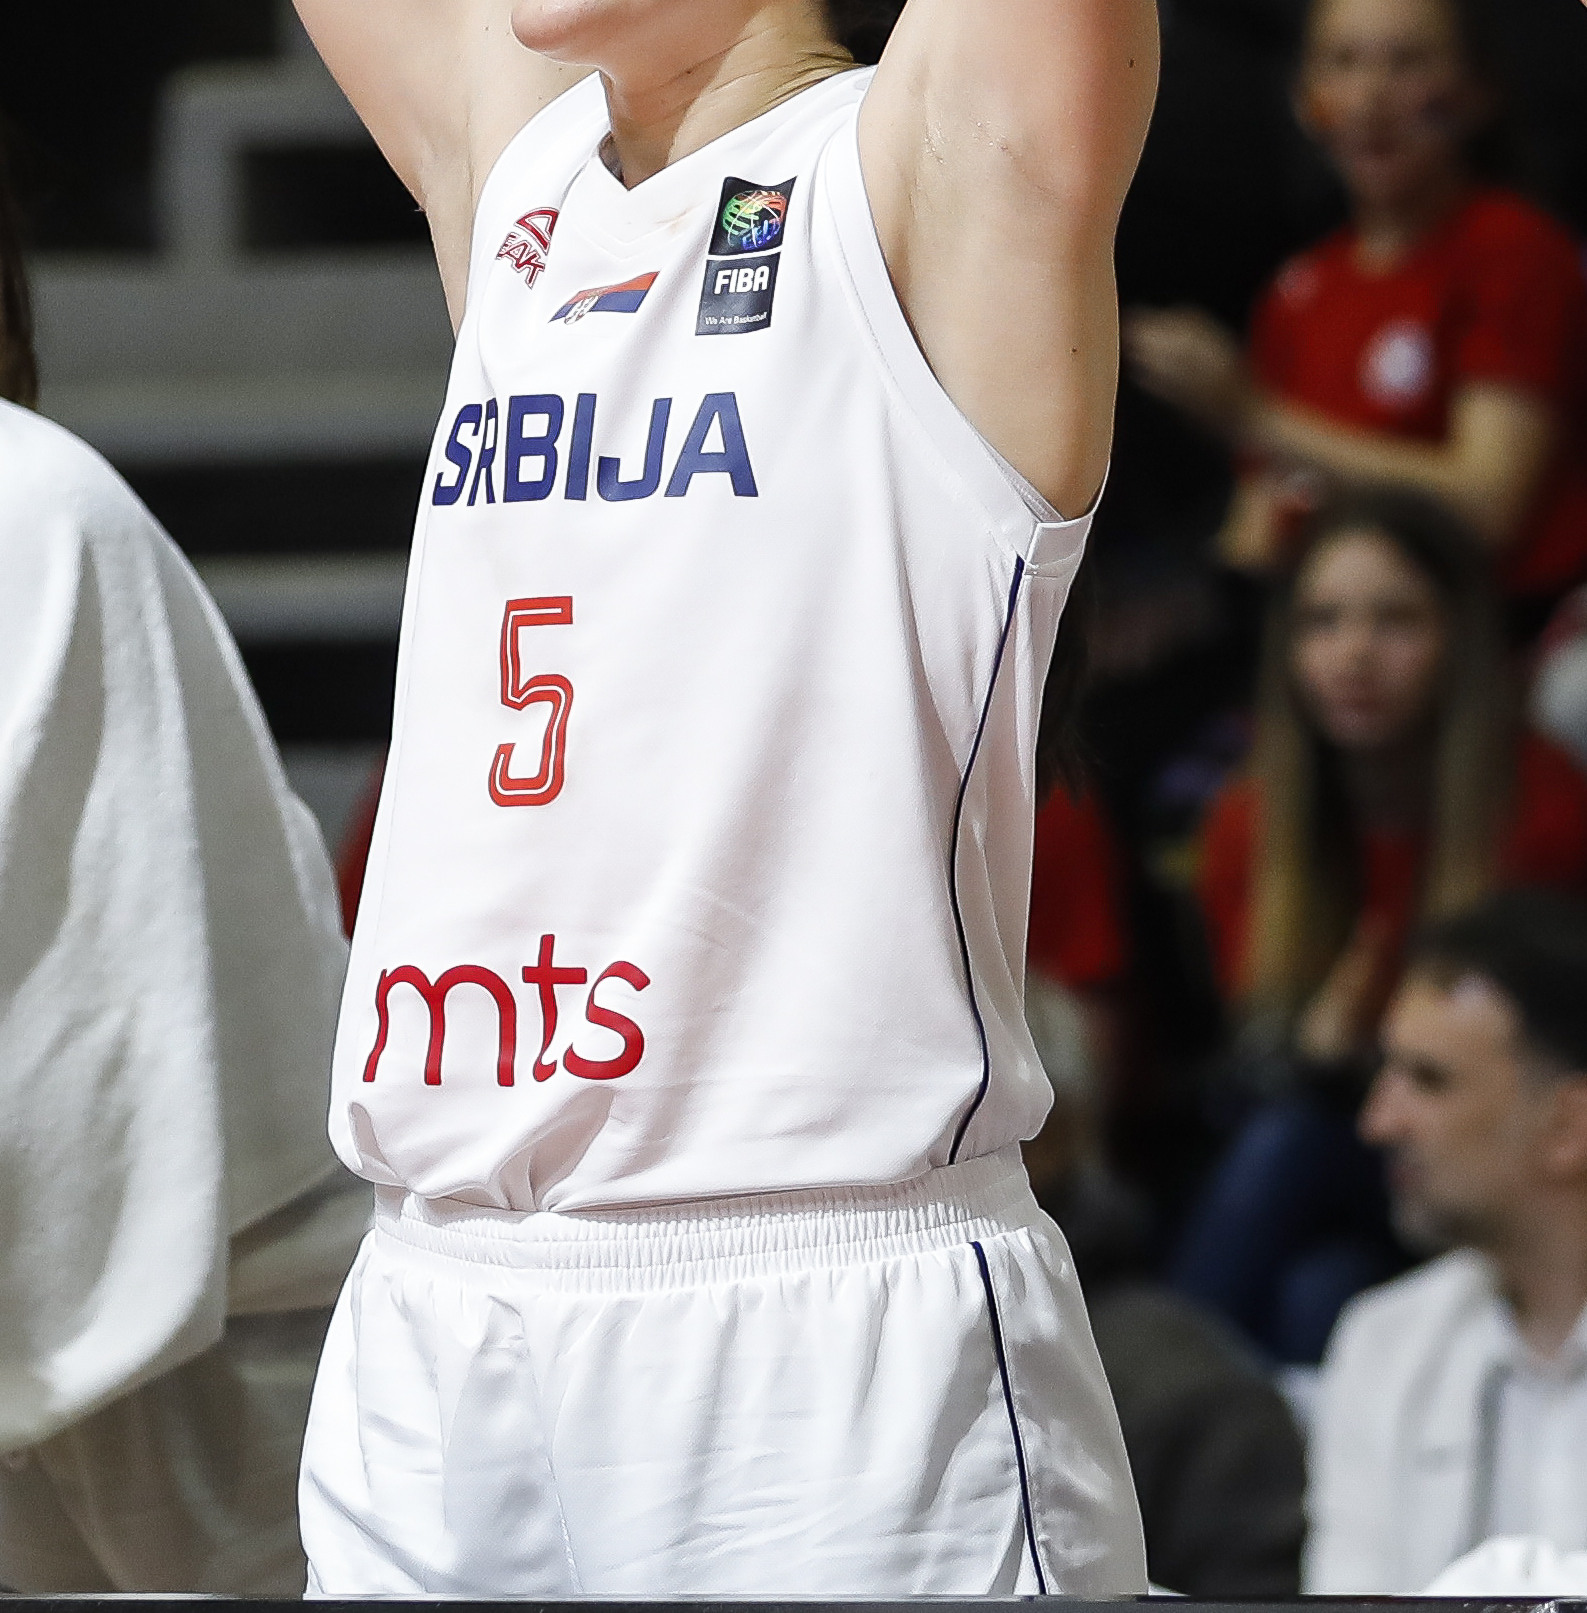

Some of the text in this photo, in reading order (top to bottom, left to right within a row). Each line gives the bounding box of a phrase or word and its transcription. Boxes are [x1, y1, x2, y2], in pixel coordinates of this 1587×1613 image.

[495, 232, 546, 289] EAK
[714, 265, 770, 295] FIBA
[432, 392, 758, 506] SRBIJA
[487, 595, 574, 807] 5
[362, 933, 651, 1087] mts
